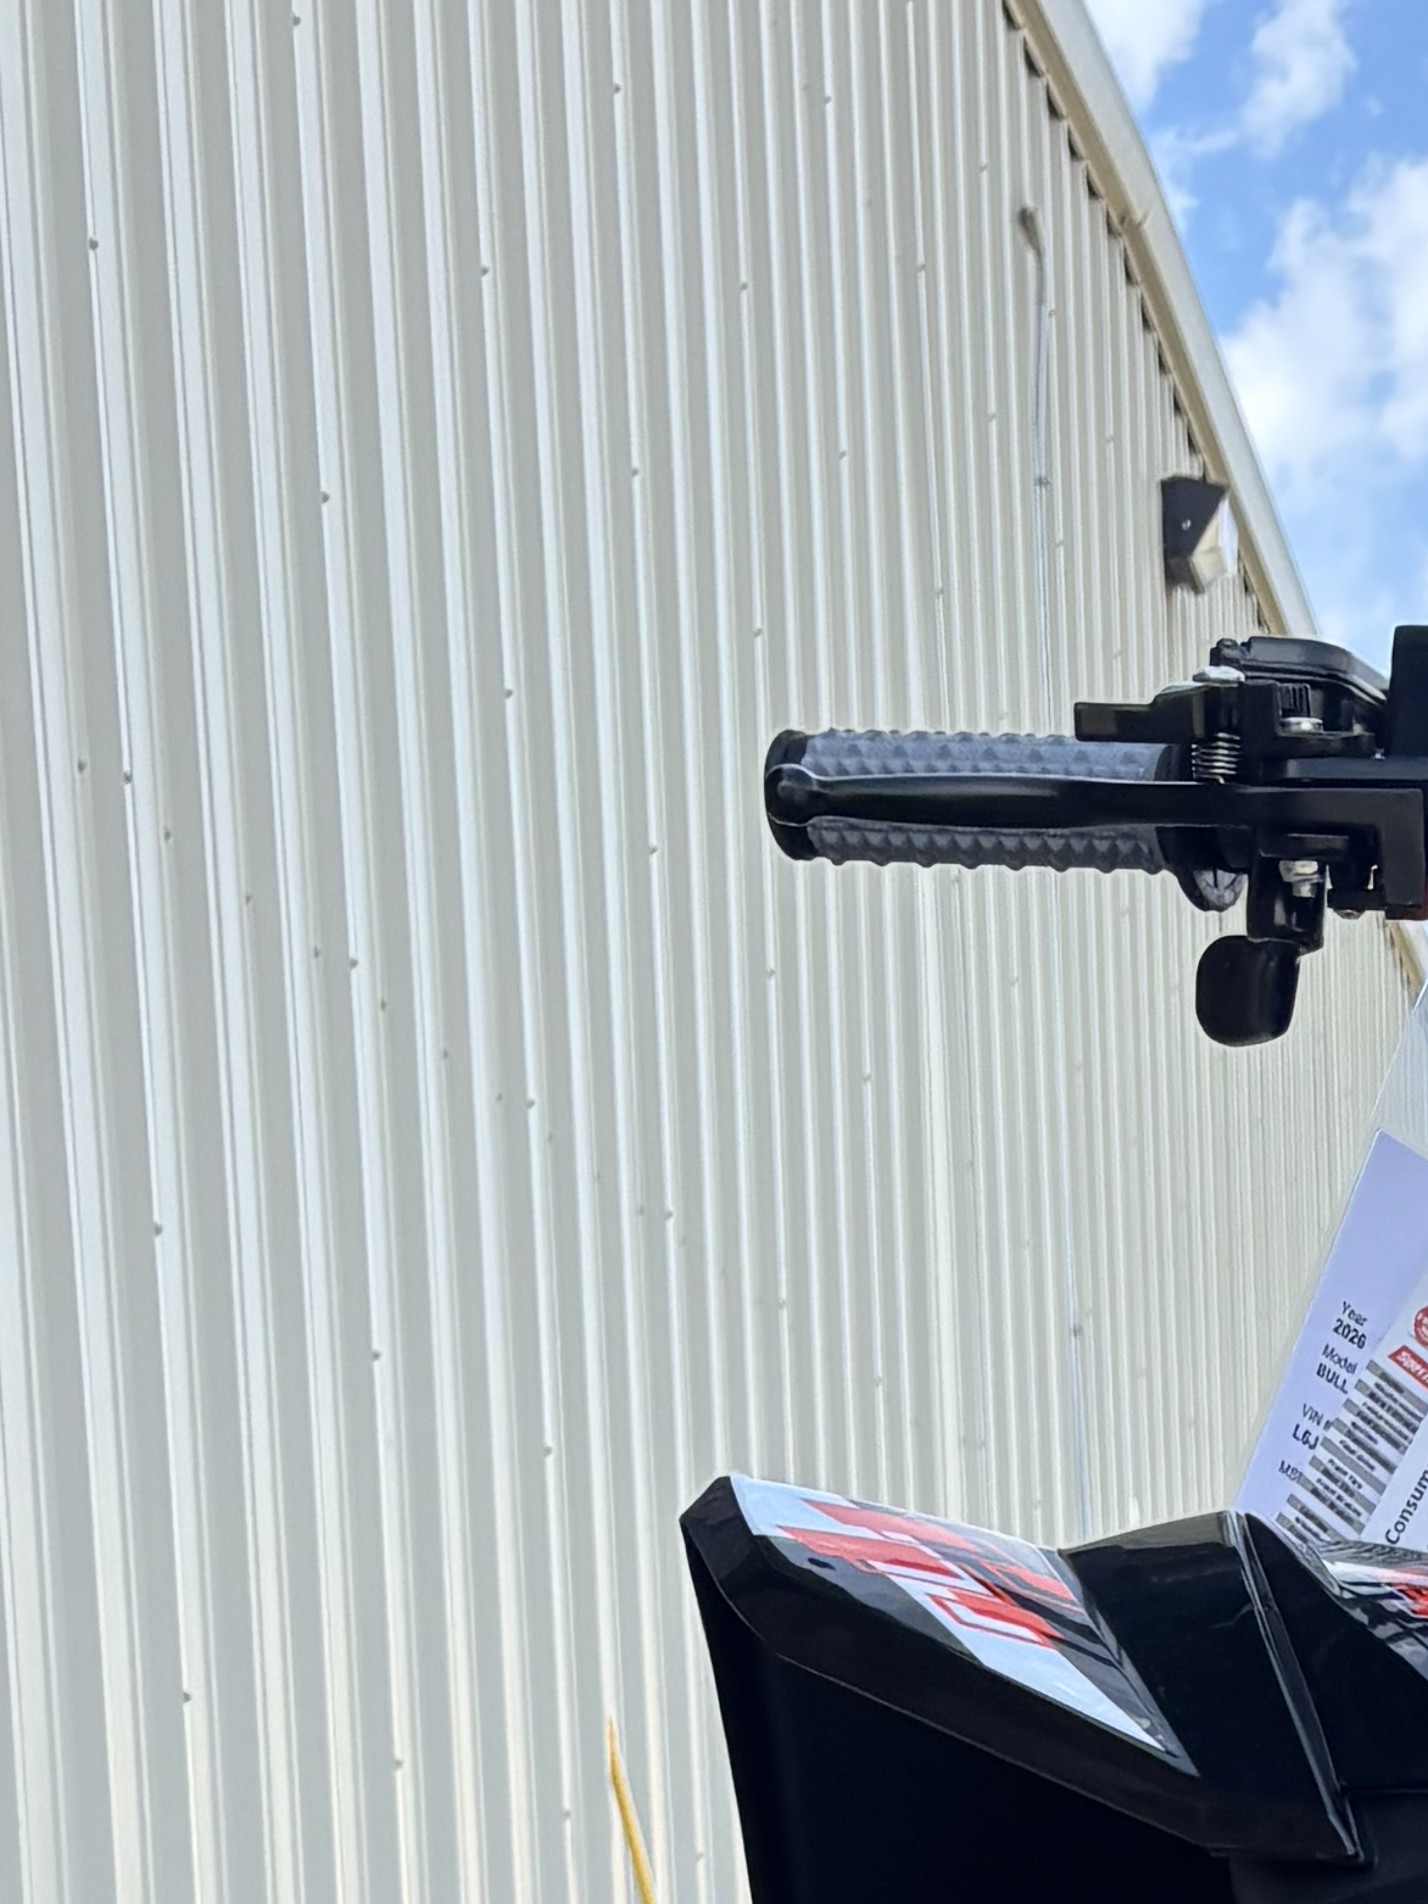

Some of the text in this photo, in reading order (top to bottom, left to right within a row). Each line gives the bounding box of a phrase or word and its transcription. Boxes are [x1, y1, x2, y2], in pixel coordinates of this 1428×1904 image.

[1342, 1300, 1368, 1327] Year
[1332, 1318, 1367, 1349] 2026
[1322, 1343, 1358, 1375] Model
[1316, 1362, 1348, 1395] BULL
[1302, 1402, 1324, 1426] VIN
